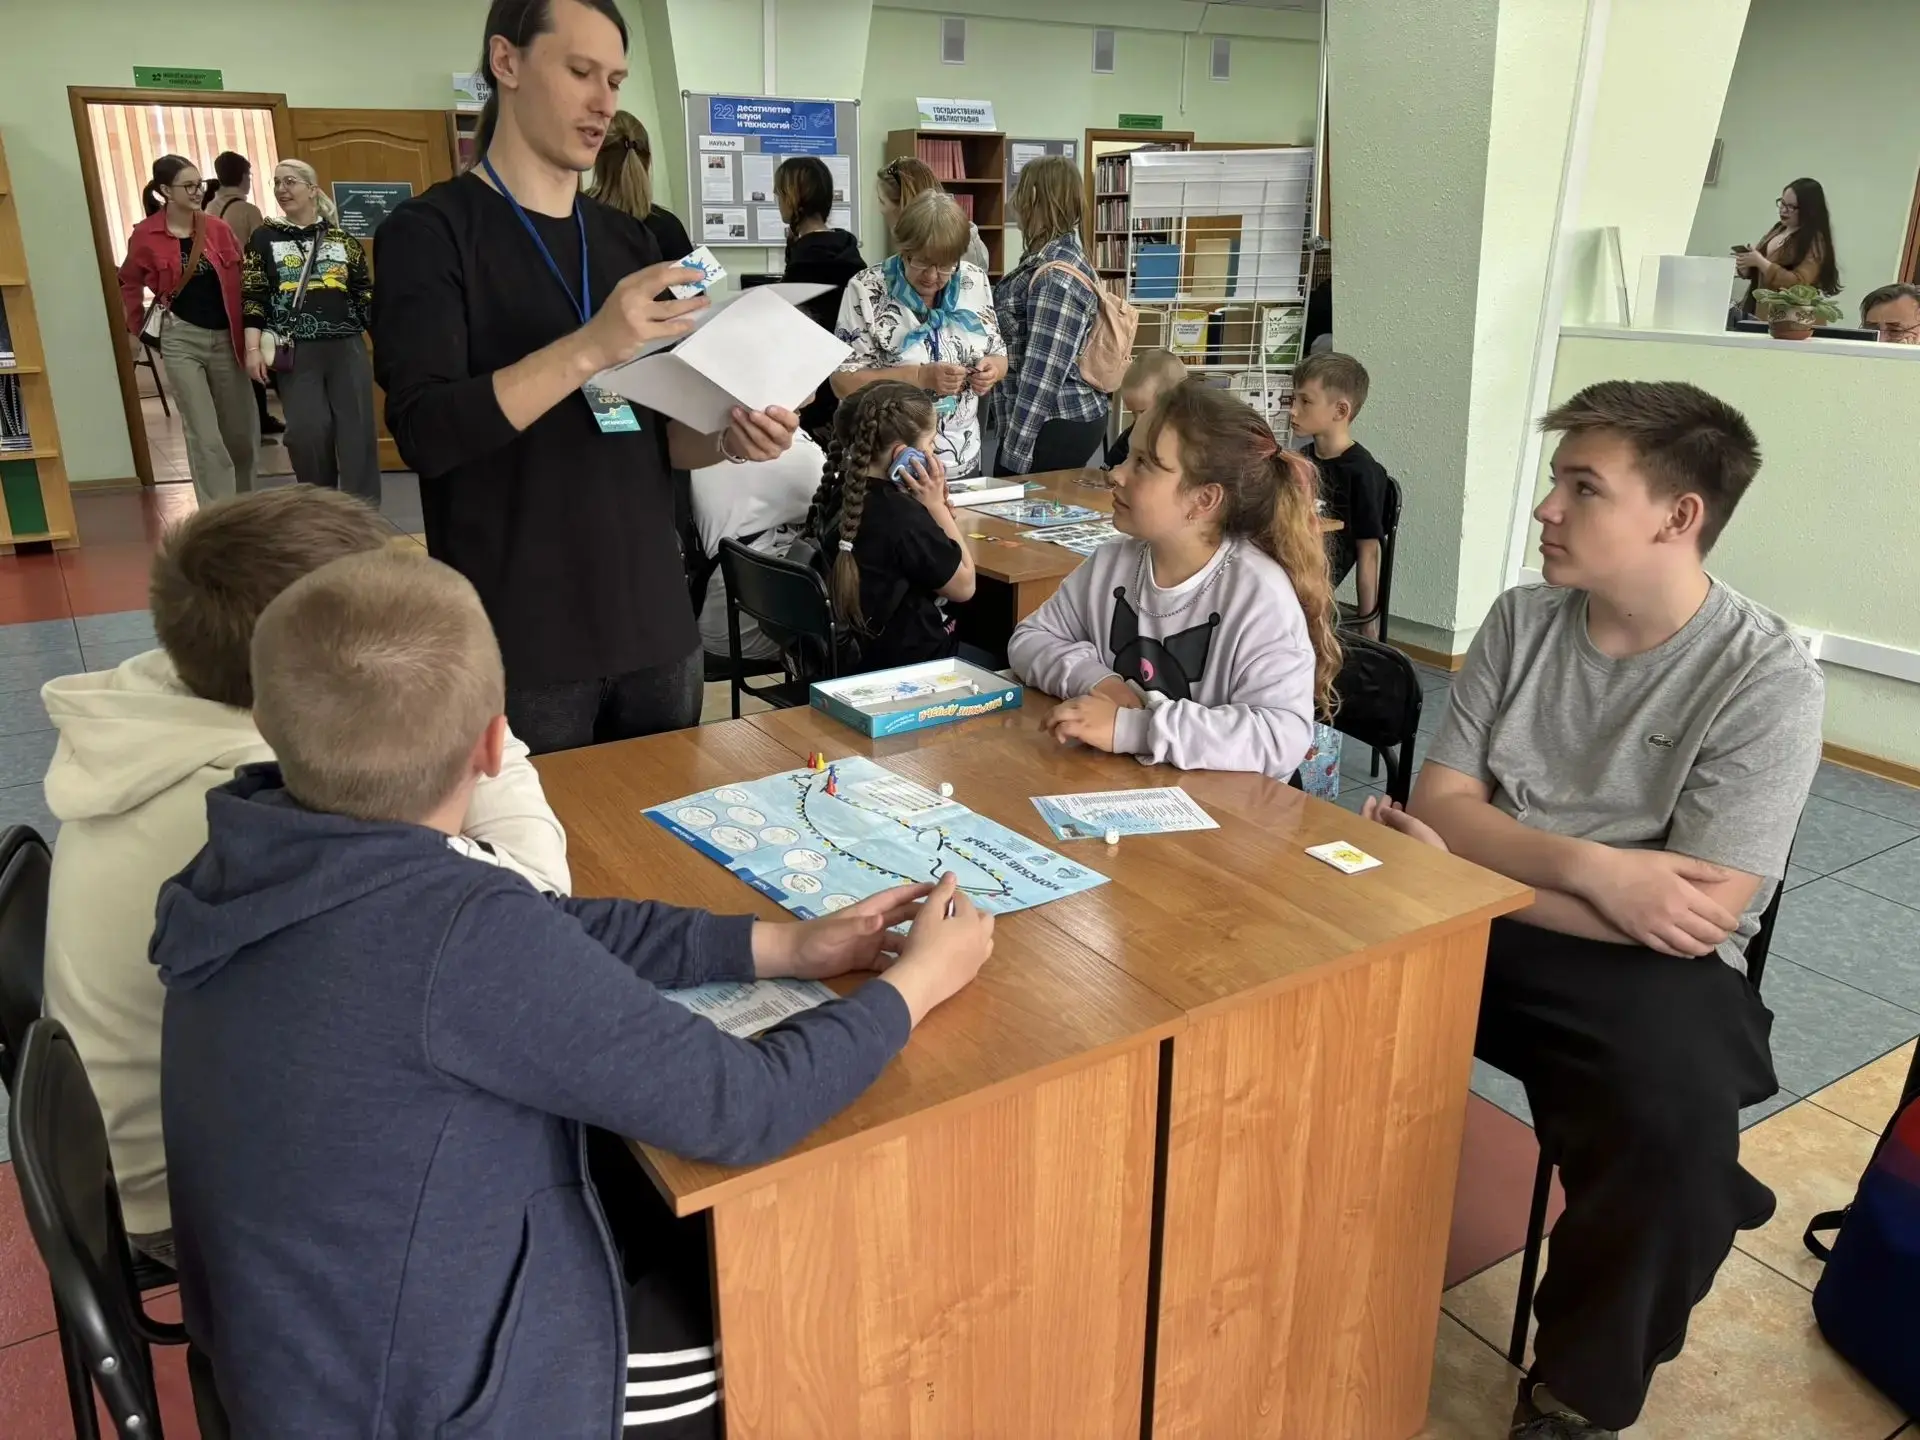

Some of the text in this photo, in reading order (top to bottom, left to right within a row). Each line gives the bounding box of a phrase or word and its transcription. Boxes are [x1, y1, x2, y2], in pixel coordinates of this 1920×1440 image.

[713, 103, 735, 120] 22
[933, 107, 986, 116] ГОСУДАРСТВЕННАЯ
[736, 113, 762, 122] науки
[934, 115, 980, 123] БИБЛИОГРАФИЯ
[744, 121, 791, 131] технологий
[791, 115, 807, 131] 31
[708, 138, 736, 147] НАУКА.РФ
[961, 836, 1012, 862] ДРУЗЬЯ
[1005, 860, 1065, 892] МОРСКИЕ
